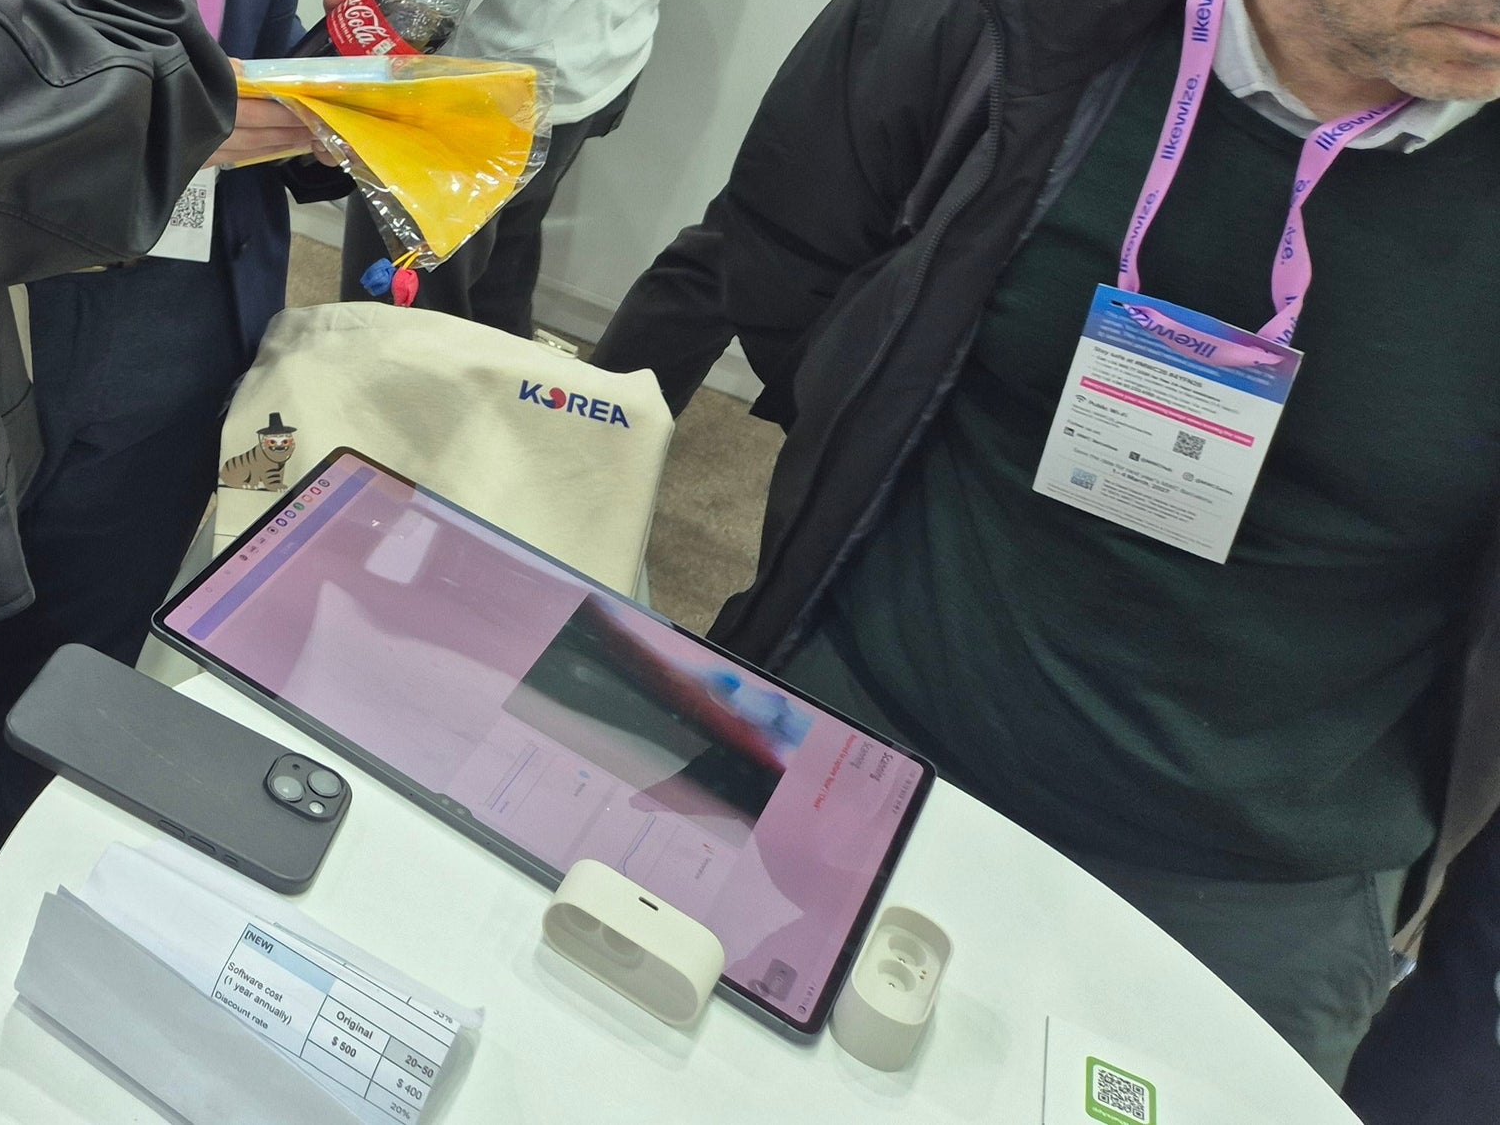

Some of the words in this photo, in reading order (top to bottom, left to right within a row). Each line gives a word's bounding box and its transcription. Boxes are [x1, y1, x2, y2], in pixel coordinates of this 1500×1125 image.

[519, 379, 630, 429] KOREA
[244, 930, 274, 954] [NEW]
[228, 962, 263, 990] Software
[265, 986, 283, 1003] cost
[215, 991, 250, 1018] Discount
[252, 1015, 268, 1029] rate
[224, 975, 233, 985] (1
[233, 982, 253, 999] year
[254, 994, 292, 1025] annually)
[336, 1010, 373, 1040] Original
[331, 1035, 339, 1047] $
[340, 1041, 357, 1058] 500
[396, 1078, 404, 1088] $
[405, 1085, 423, 1101] 400
[390, 1102, 410, 1120] 20%
